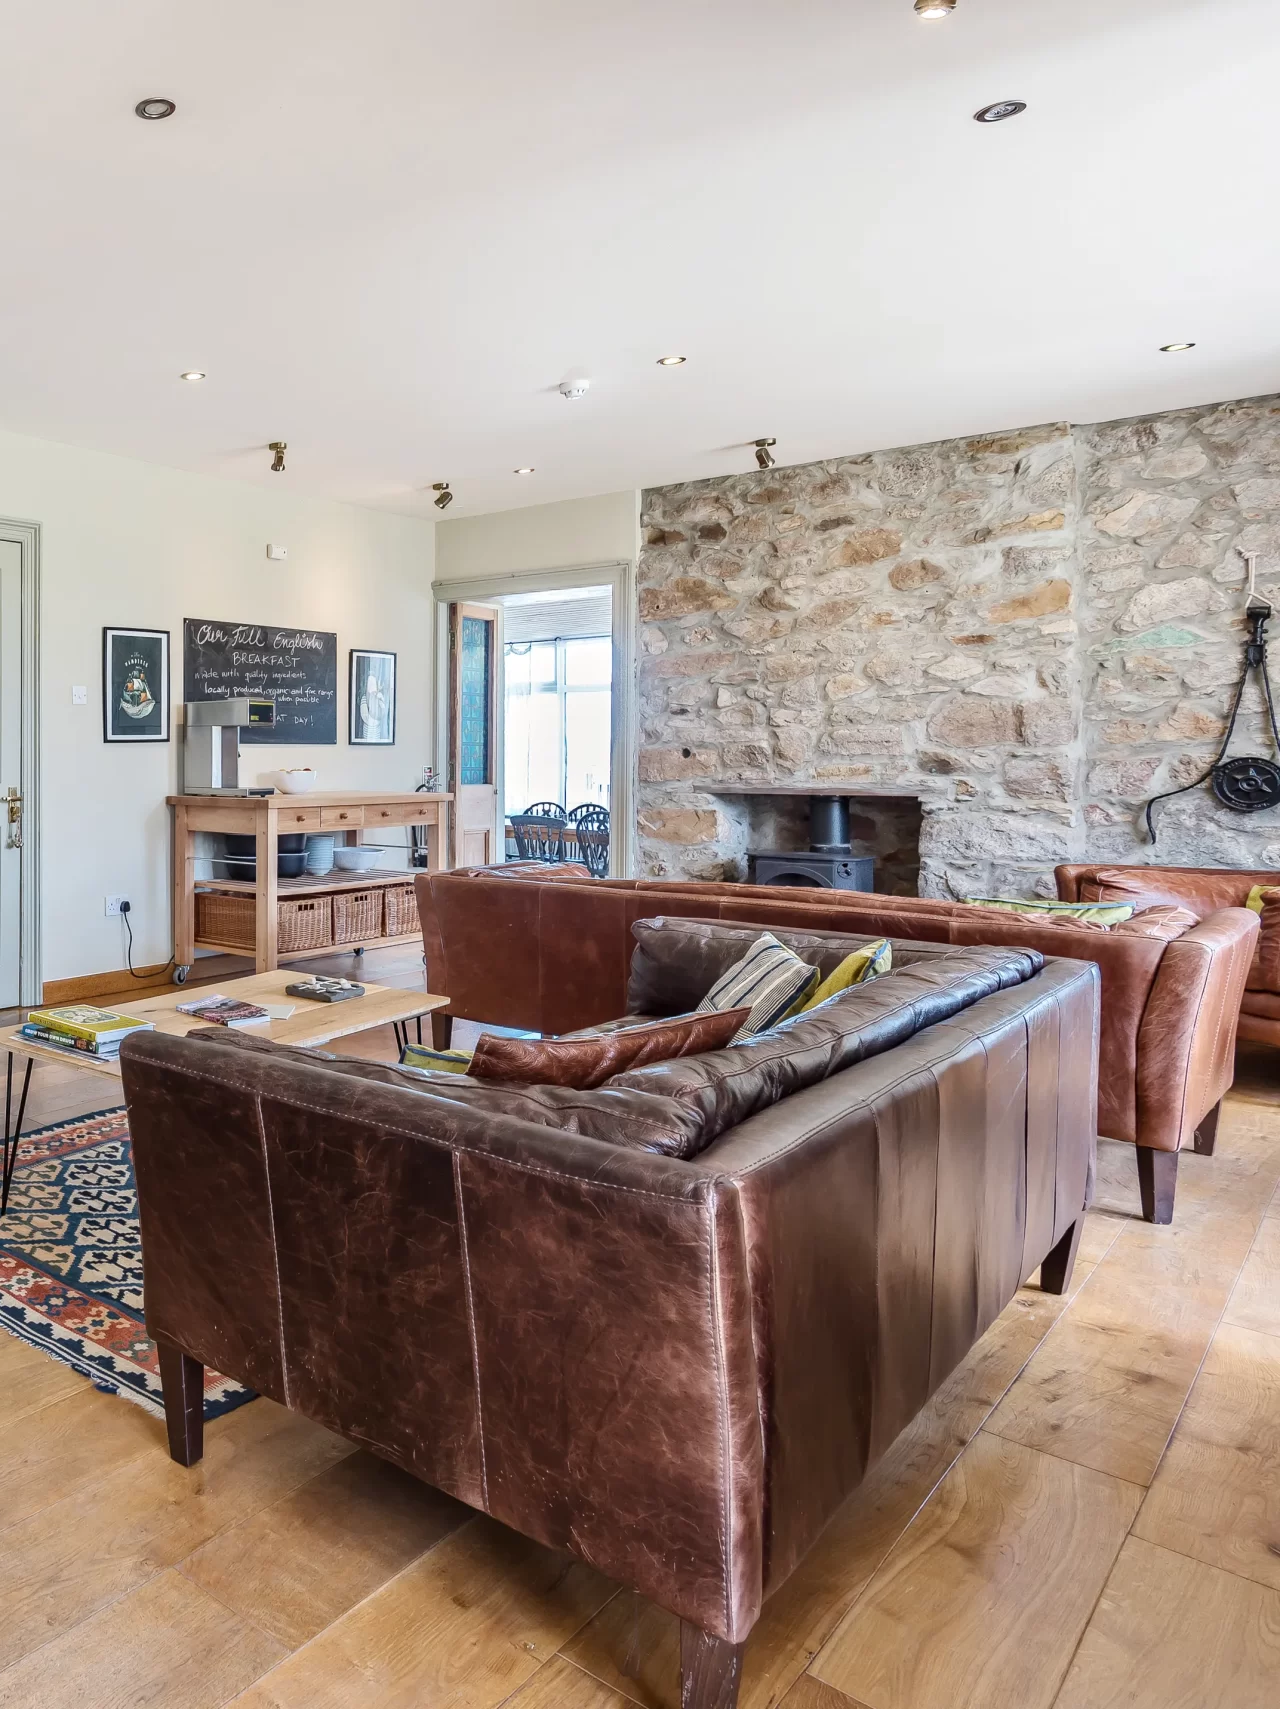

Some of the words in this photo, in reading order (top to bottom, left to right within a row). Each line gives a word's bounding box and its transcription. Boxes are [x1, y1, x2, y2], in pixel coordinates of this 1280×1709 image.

[197, 625, 227, 644] Our
[231, 626, 265, 646] Full
[273, 632, 323, 655] English
[233, 652, 300, 667] BREAKFAST
[194, 668, 219, 679] made
[221, 668, 239, 678] with
[244, 671, 268, 684] quality
[272, 671, 307, 684] ingredients
[204, 681, 230, 698] locally
[290, 686, 303, 695] and
[317, 689, 334, 699] range
[277, 694, 293, 702] when
[37, 1031, 49, 1039] YOUR
